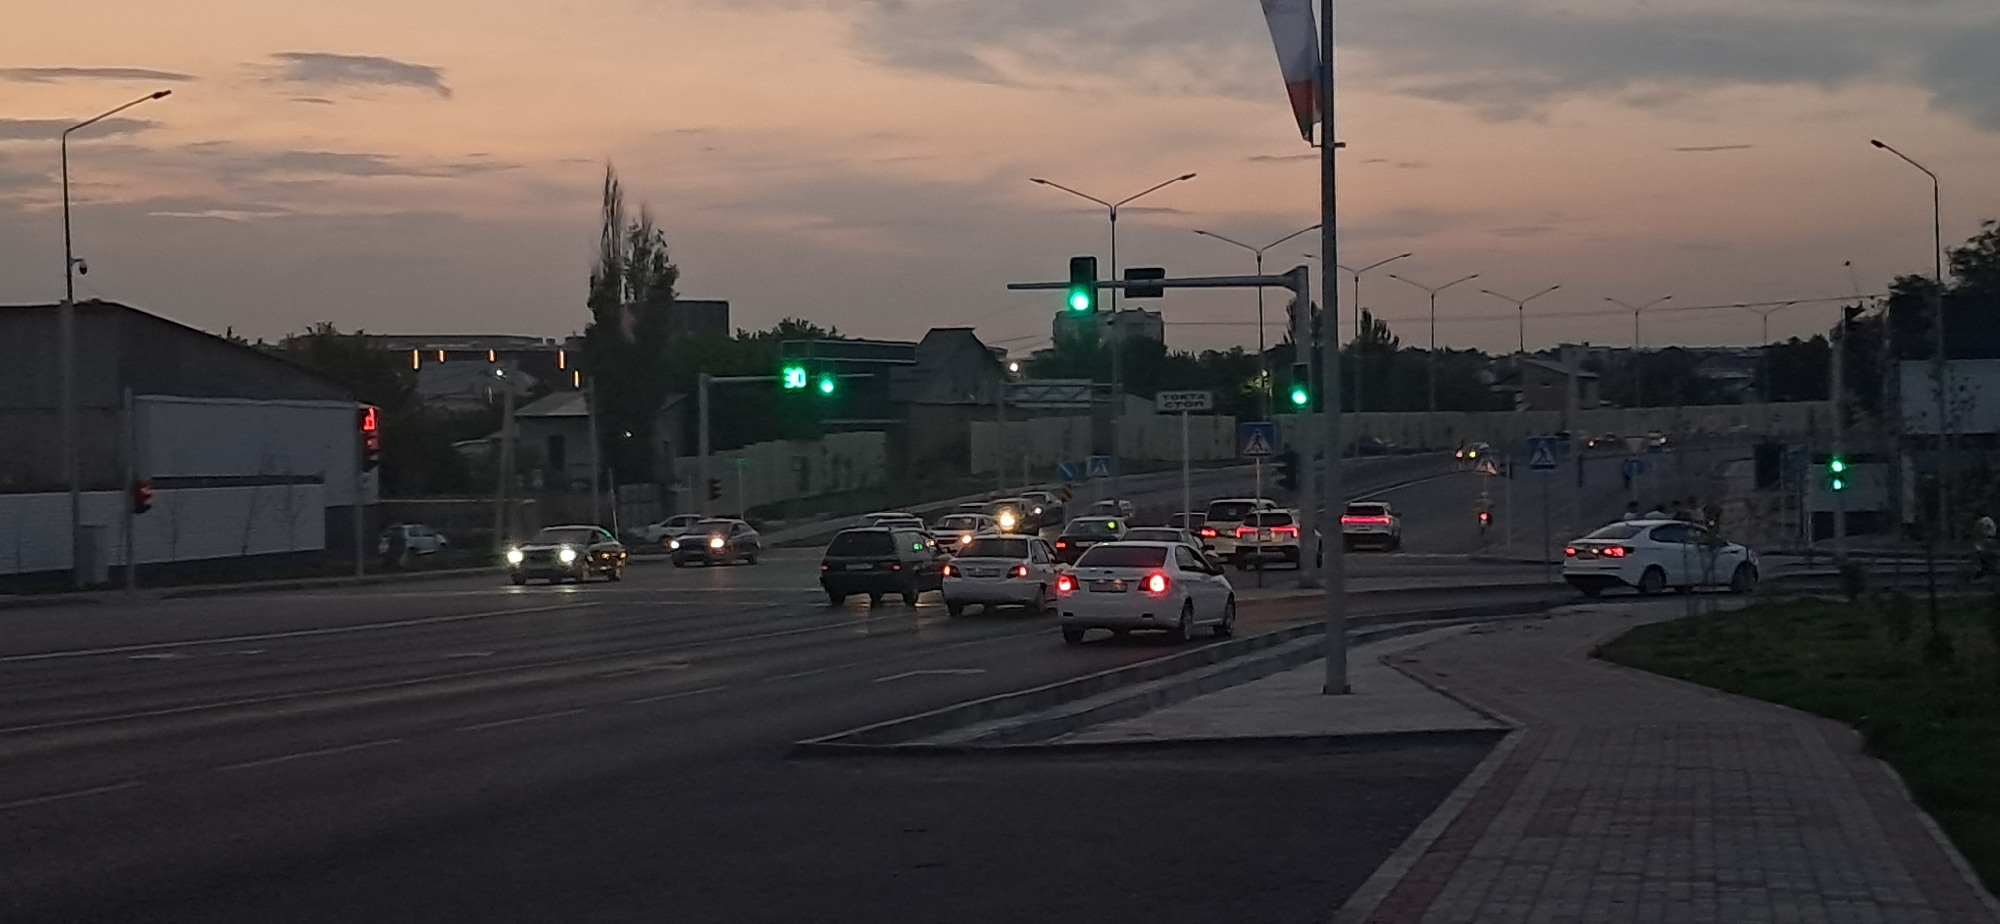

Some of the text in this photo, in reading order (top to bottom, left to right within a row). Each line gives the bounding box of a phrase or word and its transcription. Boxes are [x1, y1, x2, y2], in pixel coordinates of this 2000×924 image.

[783, 366, 807, 389] 30
[1162, 393, 1206, 401] ТОКТА
[1163, 401, 1204, 409] СТОП
